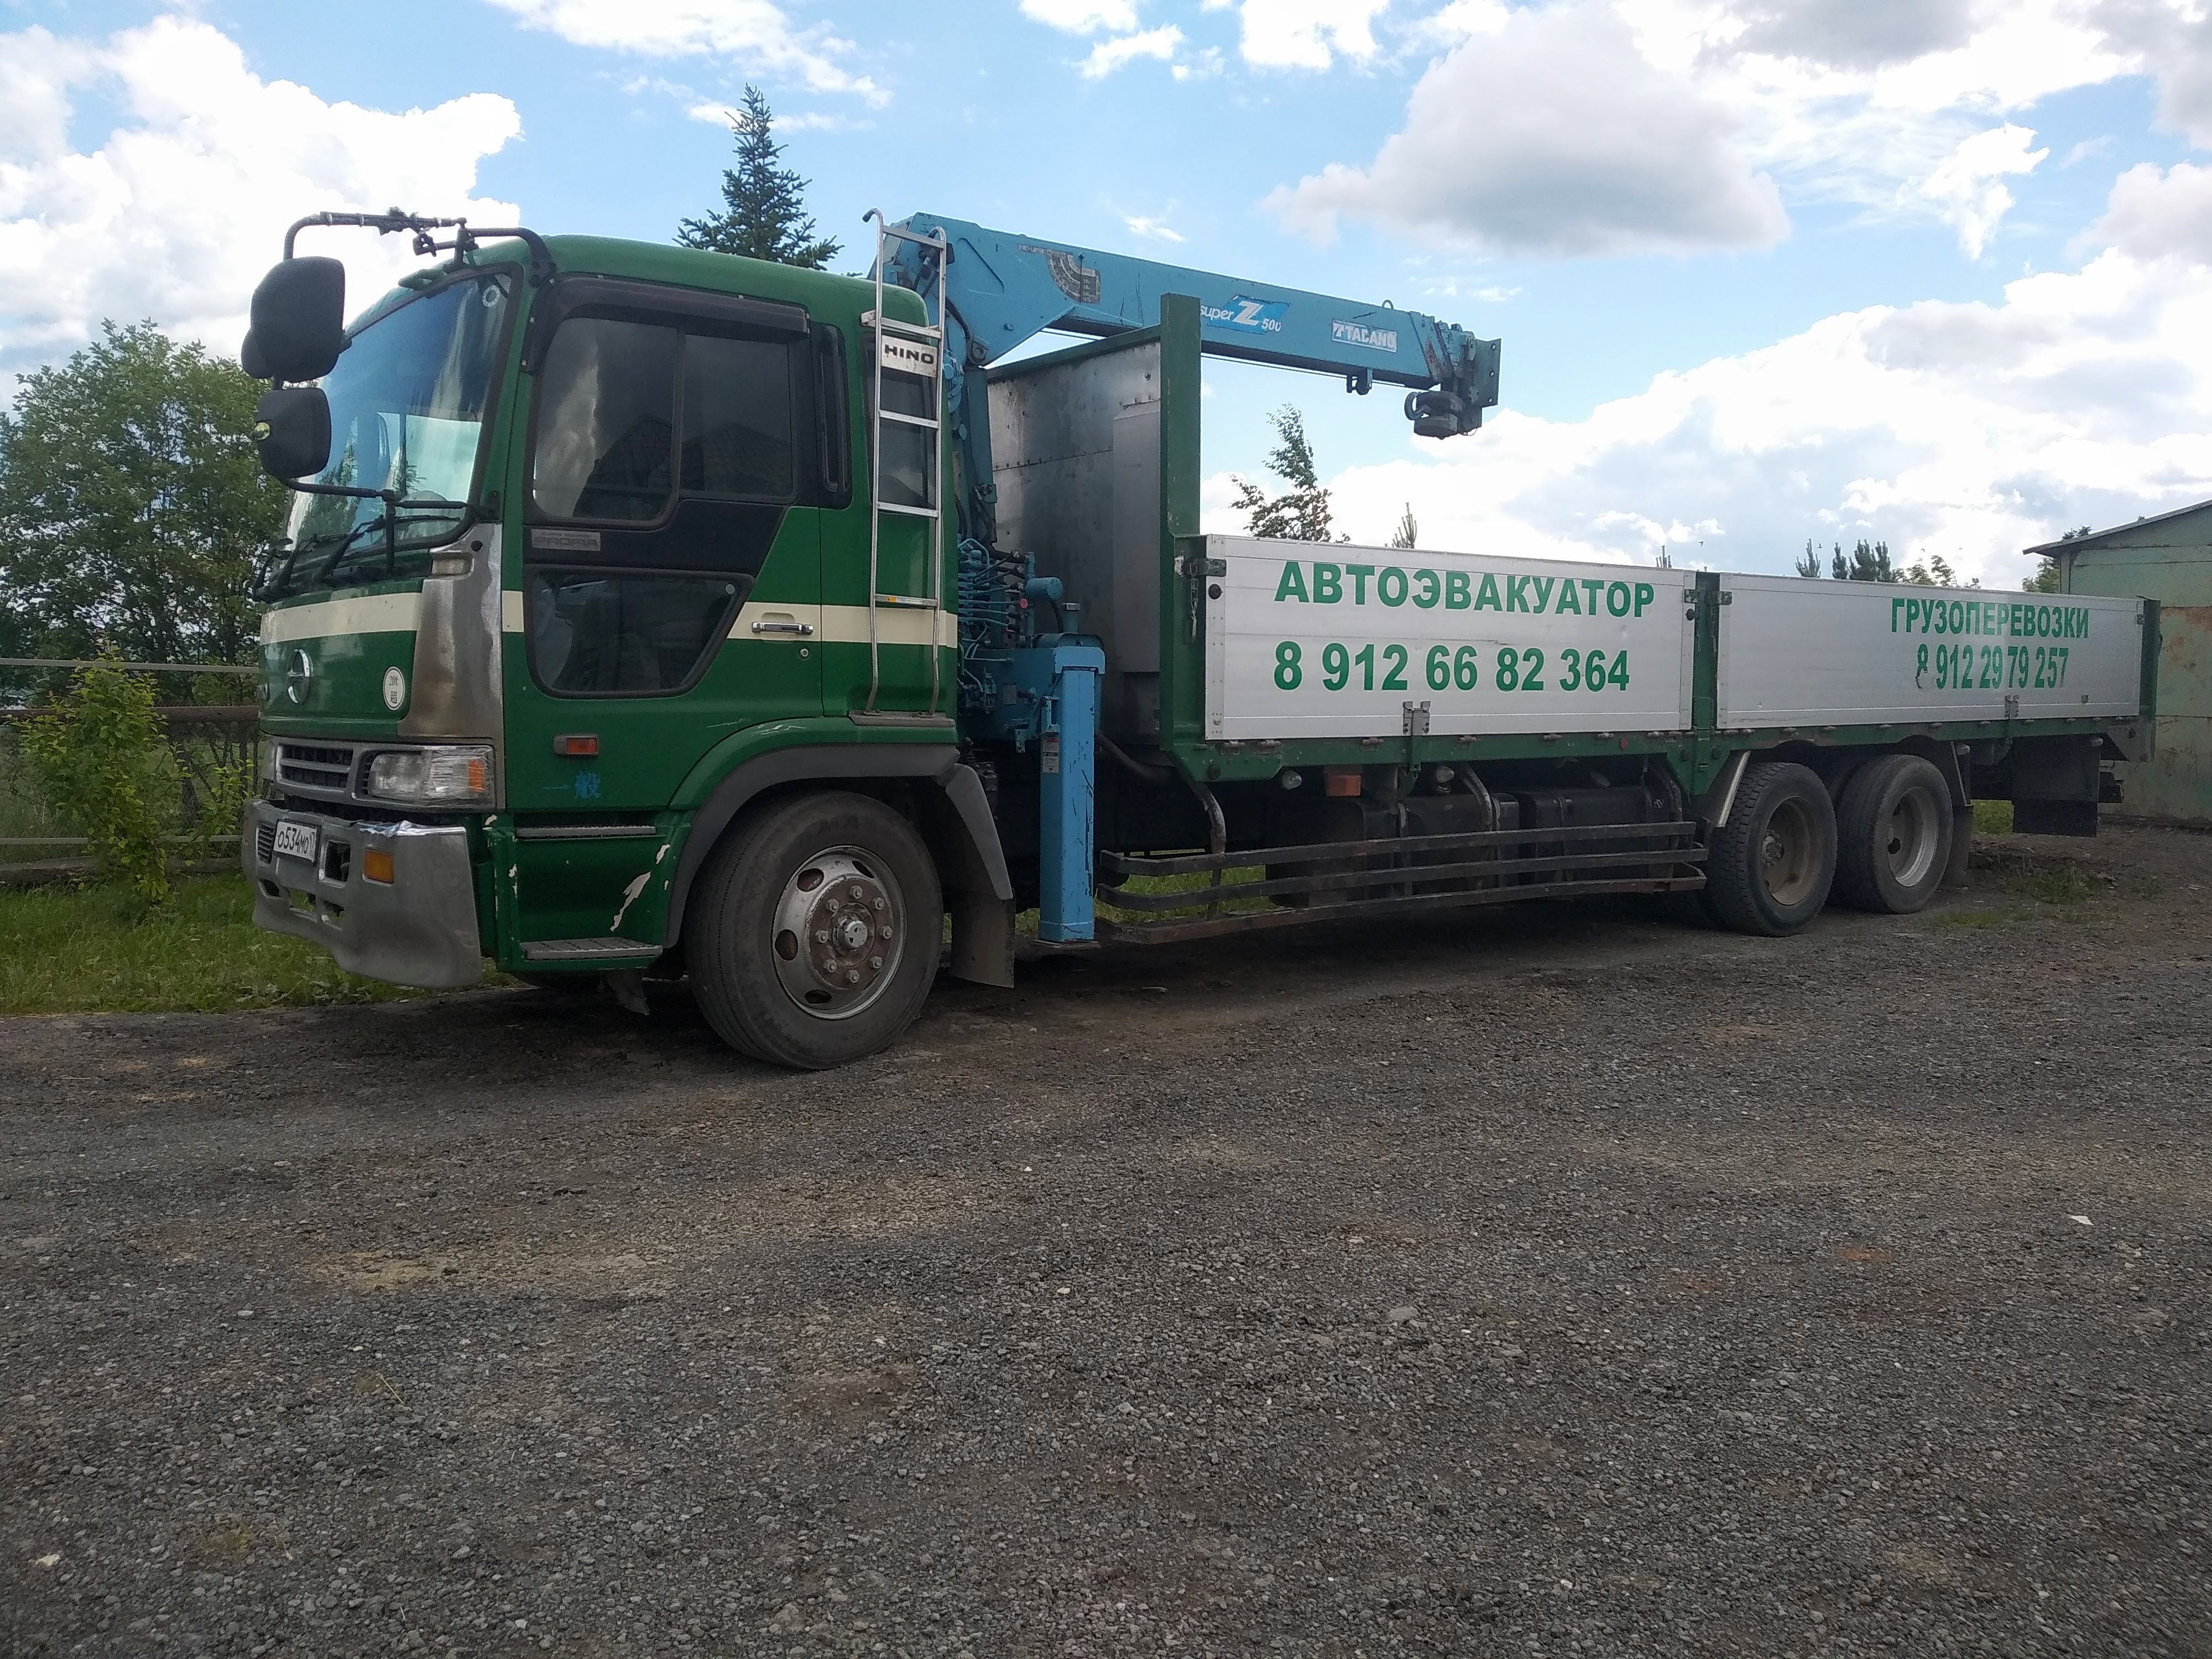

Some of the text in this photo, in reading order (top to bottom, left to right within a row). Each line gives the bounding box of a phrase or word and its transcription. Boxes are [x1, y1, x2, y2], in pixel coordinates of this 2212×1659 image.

[1200, 305, 1234, 321] super
[1232, 300, 1264, 326] Z
[884, 343, 935, 365] HINO
[1274, 561, 1655, 618] АВТОЭВАКУАТОР
[1891, 598, 2089, 639] ГРУЗОПЕРЕВОЗКИ
[1274, 641, 1630, 692] 8 912 66 82 364
[1936, 644, 1974, 689] 912
[1979, 645, 2003, 689] 29
[2007, 645, 2030, 688] 79
[2034, 646, 2069, 688] 257
